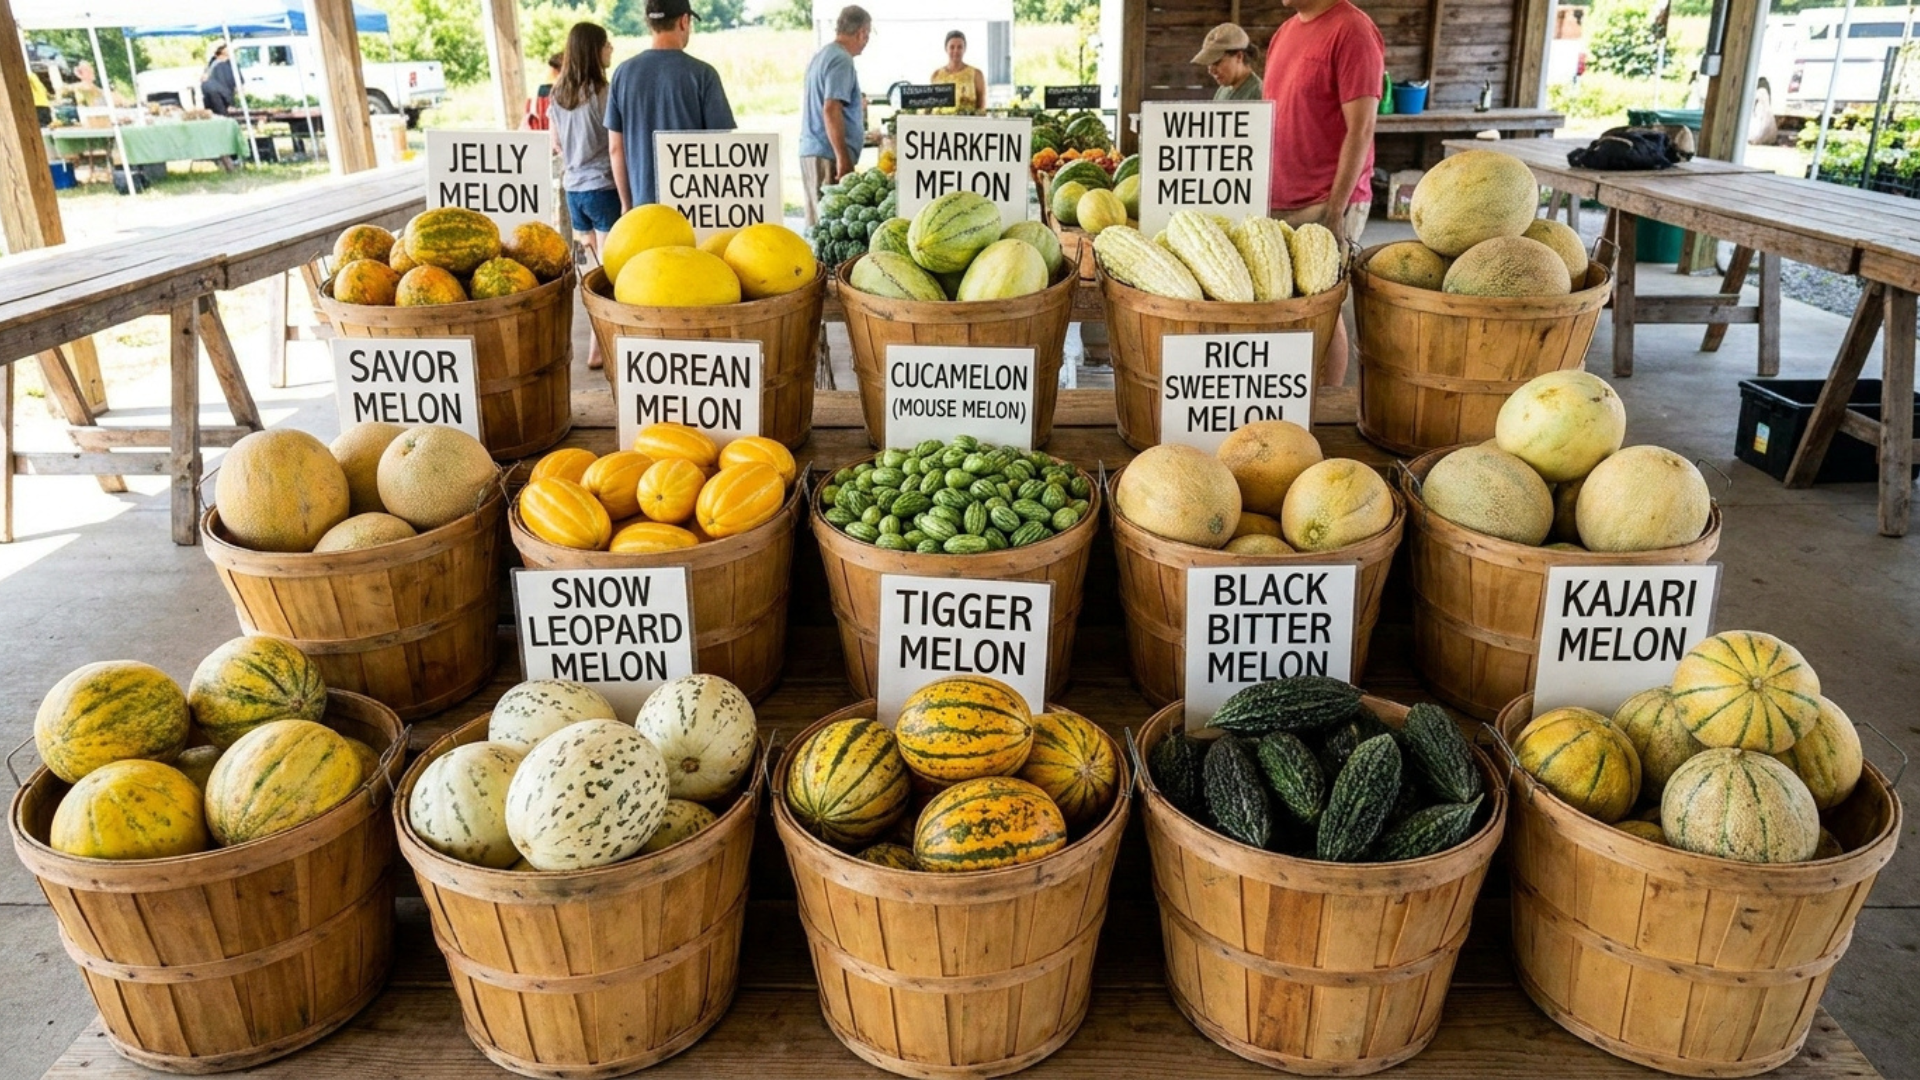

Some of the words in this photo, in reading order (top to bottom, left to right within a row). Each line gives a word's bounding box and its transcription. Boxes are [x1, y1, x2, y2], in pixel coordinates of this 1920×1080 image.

[1163, 111, 1250, 138] WHITE
[449, 143, 528, 174] JELLY
[667, 143, 769, 168] YELLOW
[905, 130, 1022, 162] SHARKFIN
[1158, 145, 1253, 171] BITTER
[440, 182, 538, 213] MELON
[670, 174, 769, 198] CANARY
[1158, 178, 1251, 205] MELON
[677, 204, 764, 228] MELON
[349, 349, 459, 383] SAVOR
[627, 351, 750, 388] KOREAN
[1205, 341, 1269, 368] RICH
[891, 362, 1028, 391] CUCAMELON
[1165, 374, 1307, 400] SWEETNESS
[353, 391, 462, 424] MELON
[636, 394, 741, 430] MELON
[893, 398, 957, 420] (MOUSE
[963, 399, 1026, 424] MELON)
[552, 575, 651, 609] SNOW
[1214, 572, 1328, 606] BLACK
[1562, 580, 1698, 617] KAJARI
[896, 589, 1033, 631] TIGGER
[529, 613, 682, 647] LEOPARD
[1208, 613, 1332, 645] BITTER
[1558, 627, 1687, 662] MELON
[551, 651, 667, 683] MELON
[900, 635, 1026, 675] MELON
[1208, 651, 1328, 683] MELON
